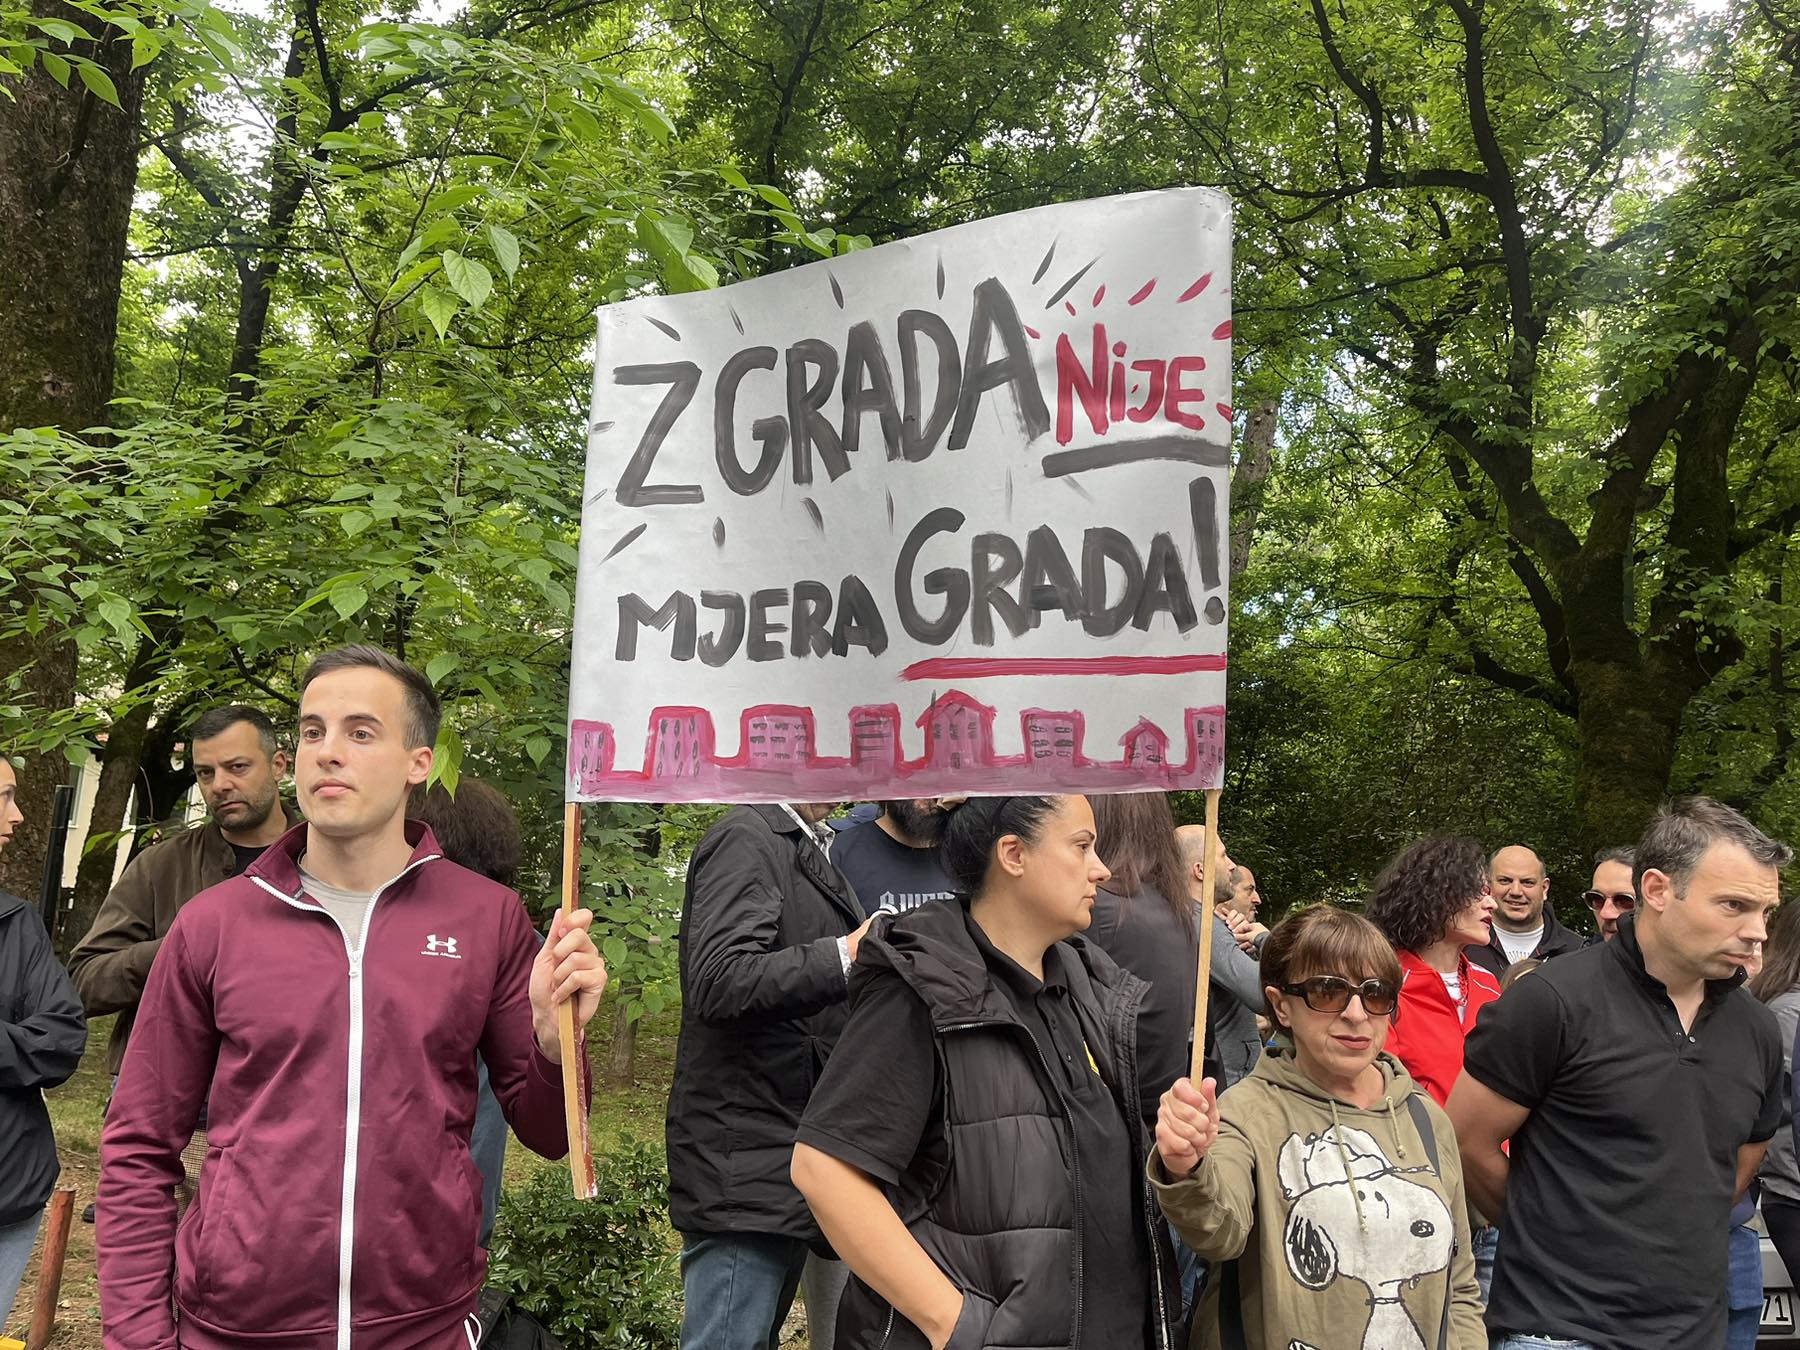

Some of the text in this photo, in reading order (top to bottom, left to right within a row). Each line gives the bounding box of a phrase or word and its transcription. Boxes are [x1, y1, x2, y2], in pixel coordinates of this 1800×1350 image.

[612, 276, 1051, 506] ZGRADA
[615, 476, 1227, 668] MJERA GRADA!
